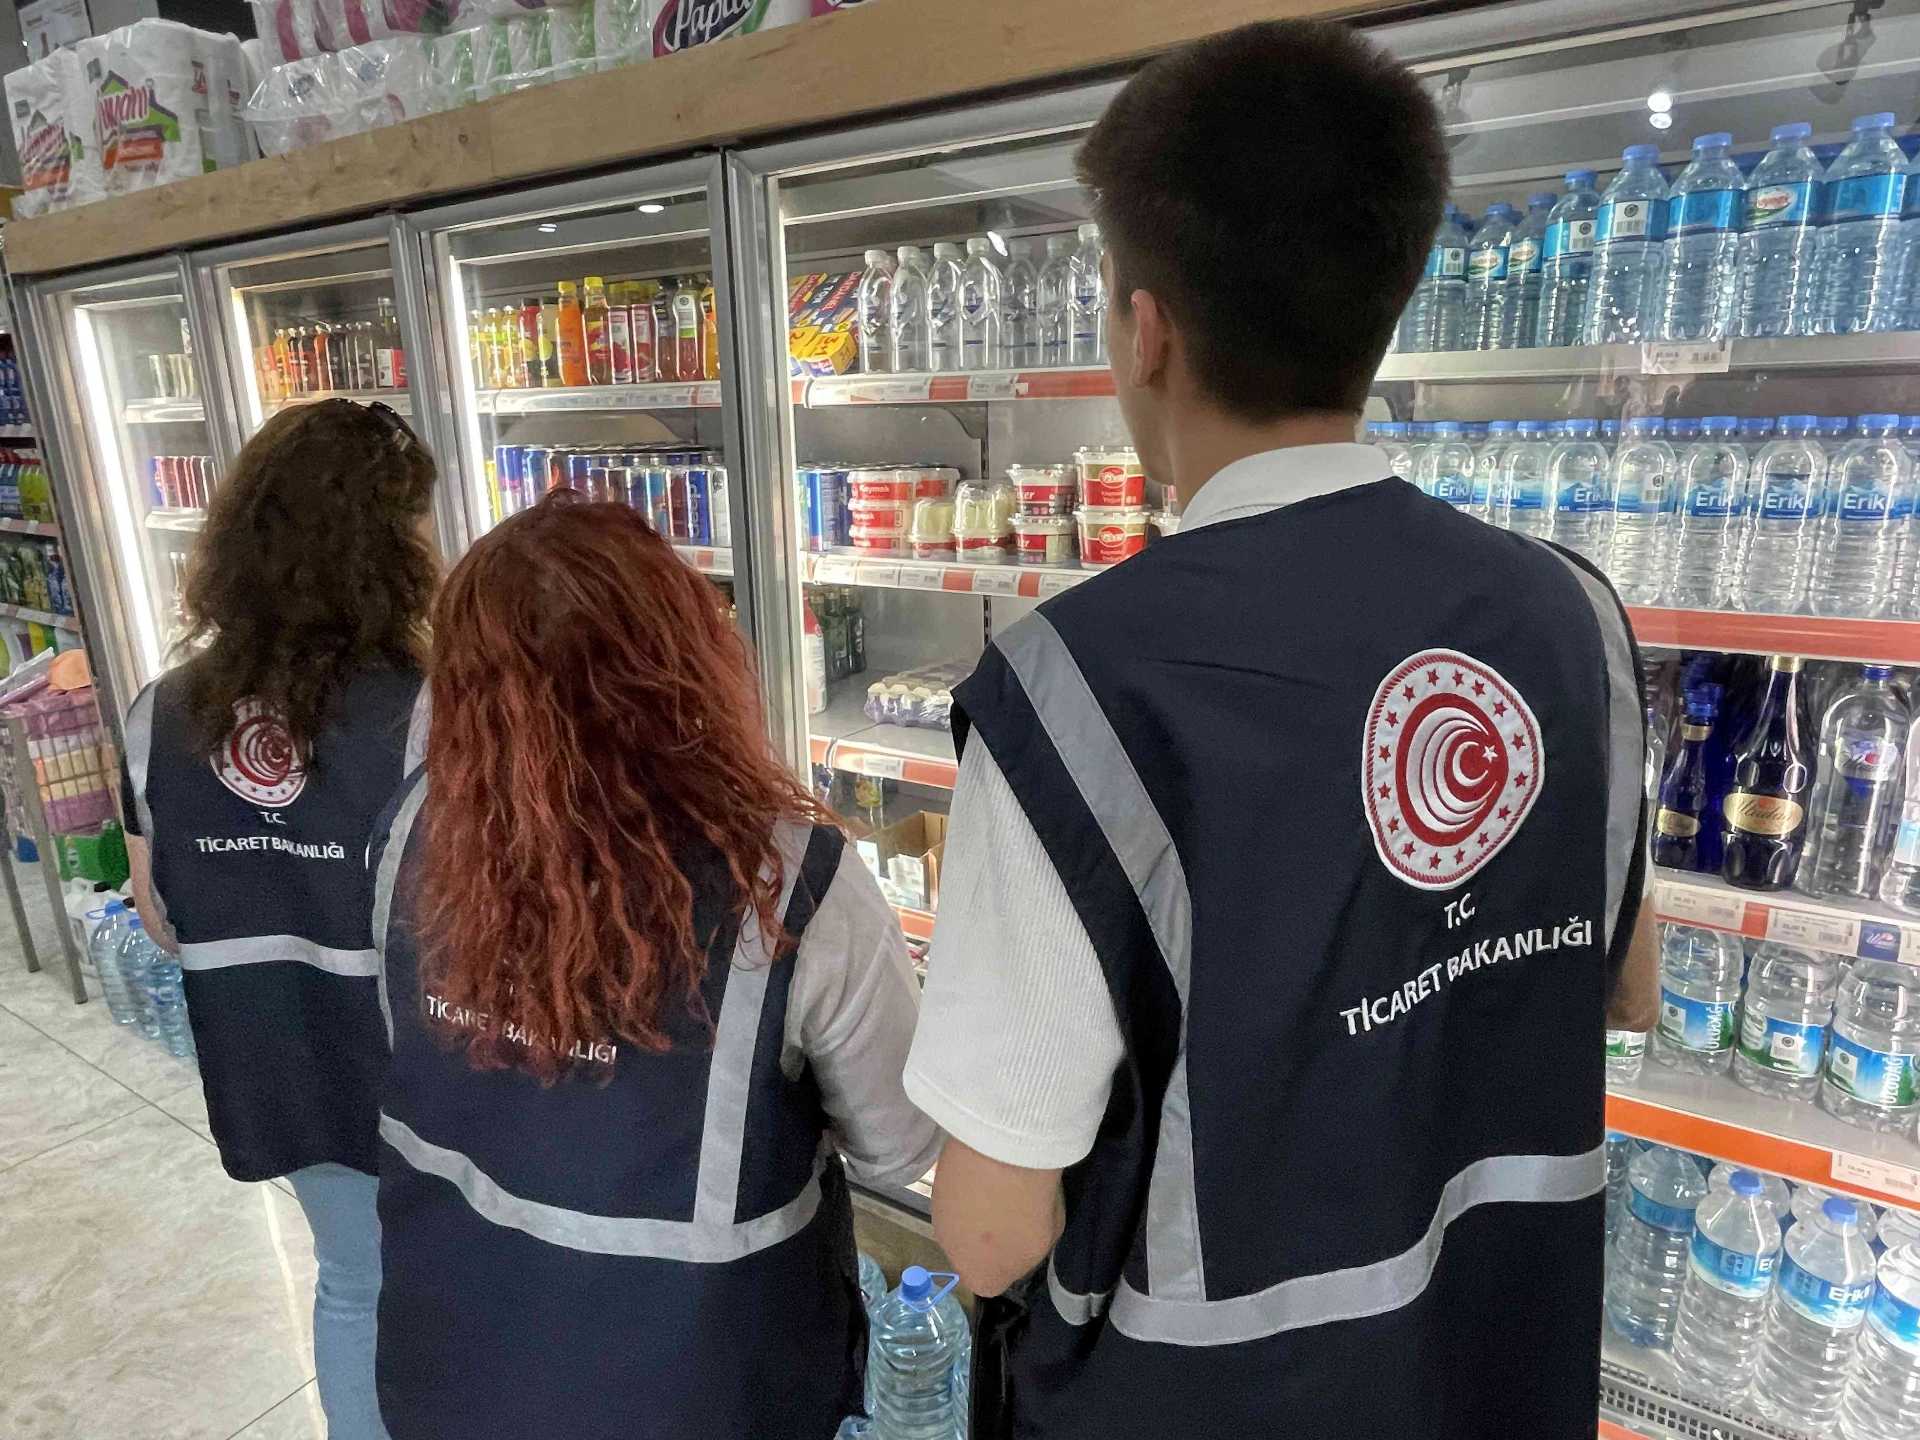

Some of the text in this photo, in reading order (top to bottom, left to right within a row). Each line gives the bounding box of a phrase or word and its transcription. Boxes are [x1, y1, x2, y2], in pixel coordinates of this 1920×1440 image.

[195, 836, 346, 860] TİCARET BAKANLIĞI
[1339, 916, 1593, 1036] TİCARET BAKANLIĞI
